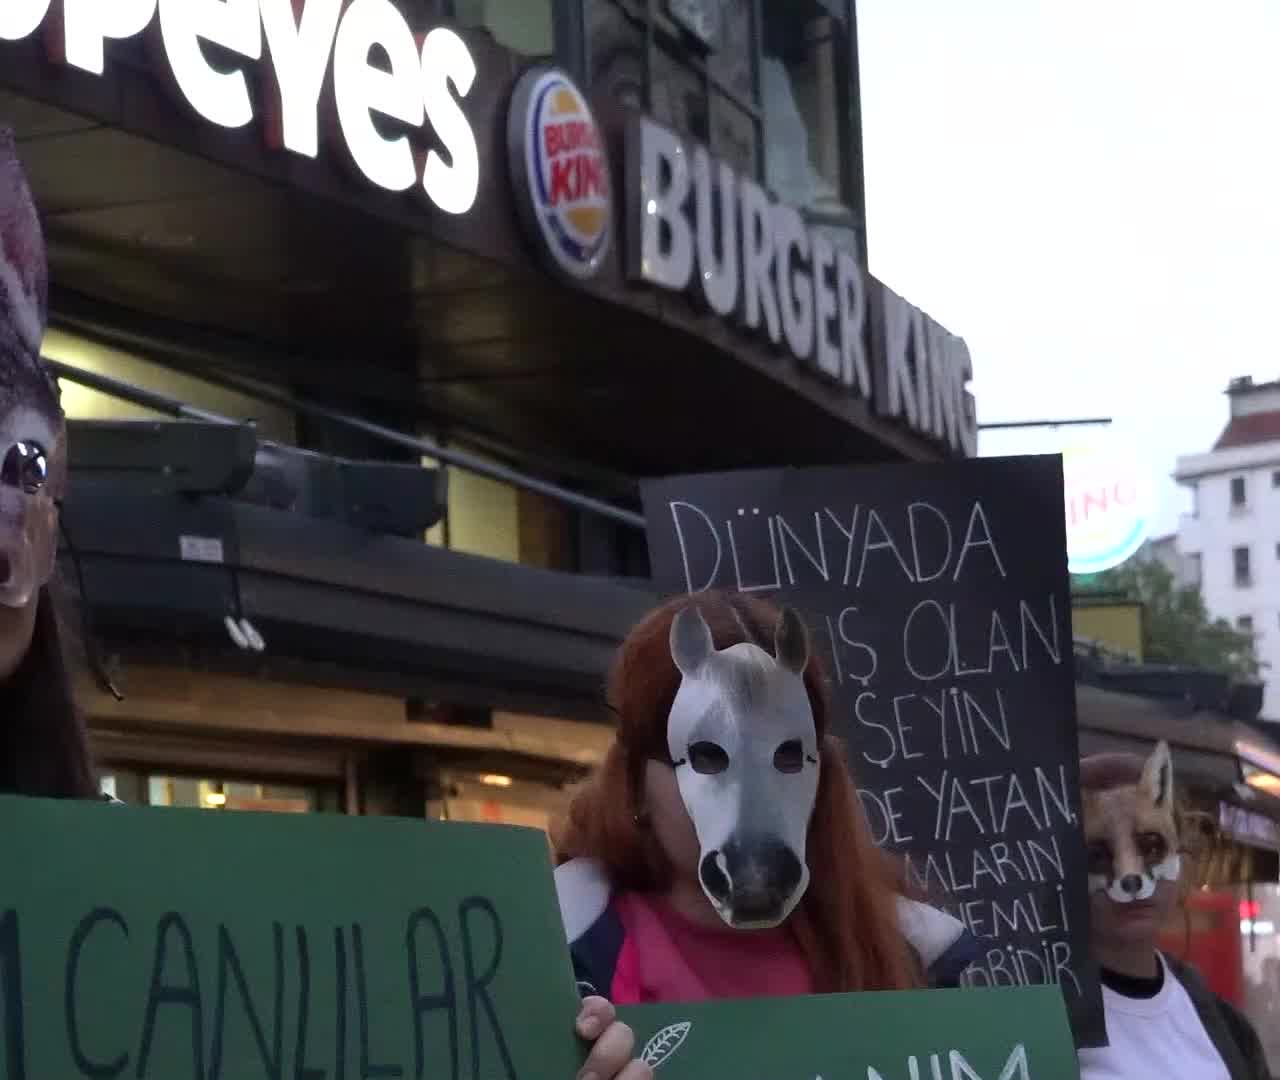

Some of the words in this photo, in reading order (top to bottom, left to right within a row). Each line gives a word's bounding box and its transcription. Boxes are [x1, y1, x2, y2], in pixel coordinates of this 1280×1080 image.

[639, 115, 870, 402] BURGER
[671, 500, 1008, 594] DÜNYADA
[903, 594, 1063, 681] OLAN
